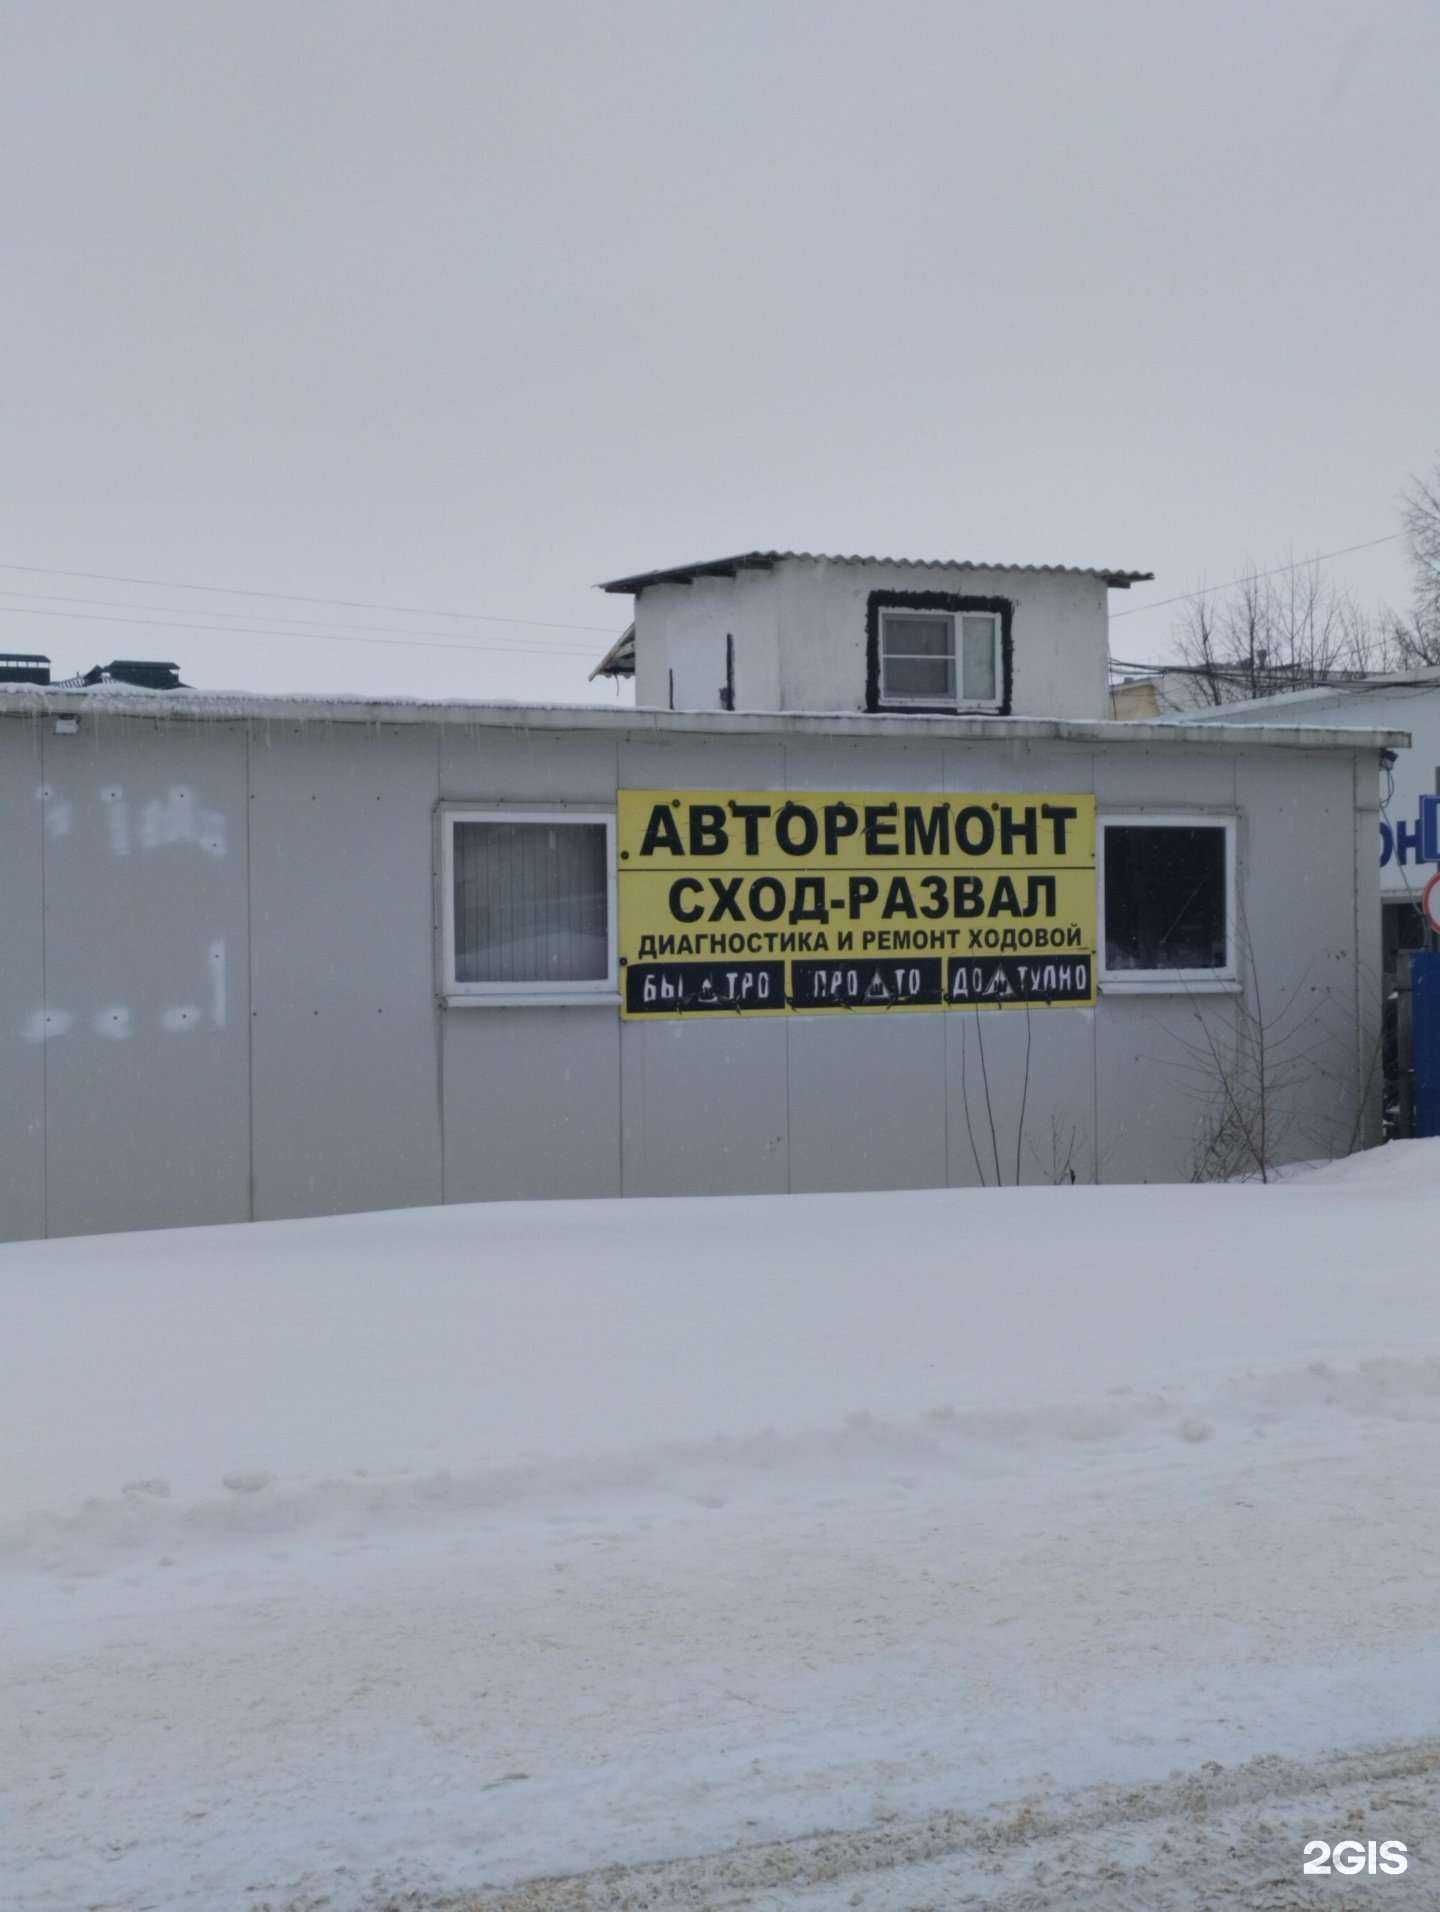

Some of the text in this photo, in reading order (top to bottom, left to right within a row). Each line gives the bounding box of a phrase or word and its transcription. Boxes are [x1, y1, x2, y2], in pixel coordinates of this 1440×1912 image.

[639, 804, 1078, 857] АВТОРЕМОНТ
[668, 875, 1057, 925] СХОД-РАЗВАЛ
[638, 922, 1083, 960] ДИАГНОСТИКА И РЕМОНТ ХОДОВОЙ
